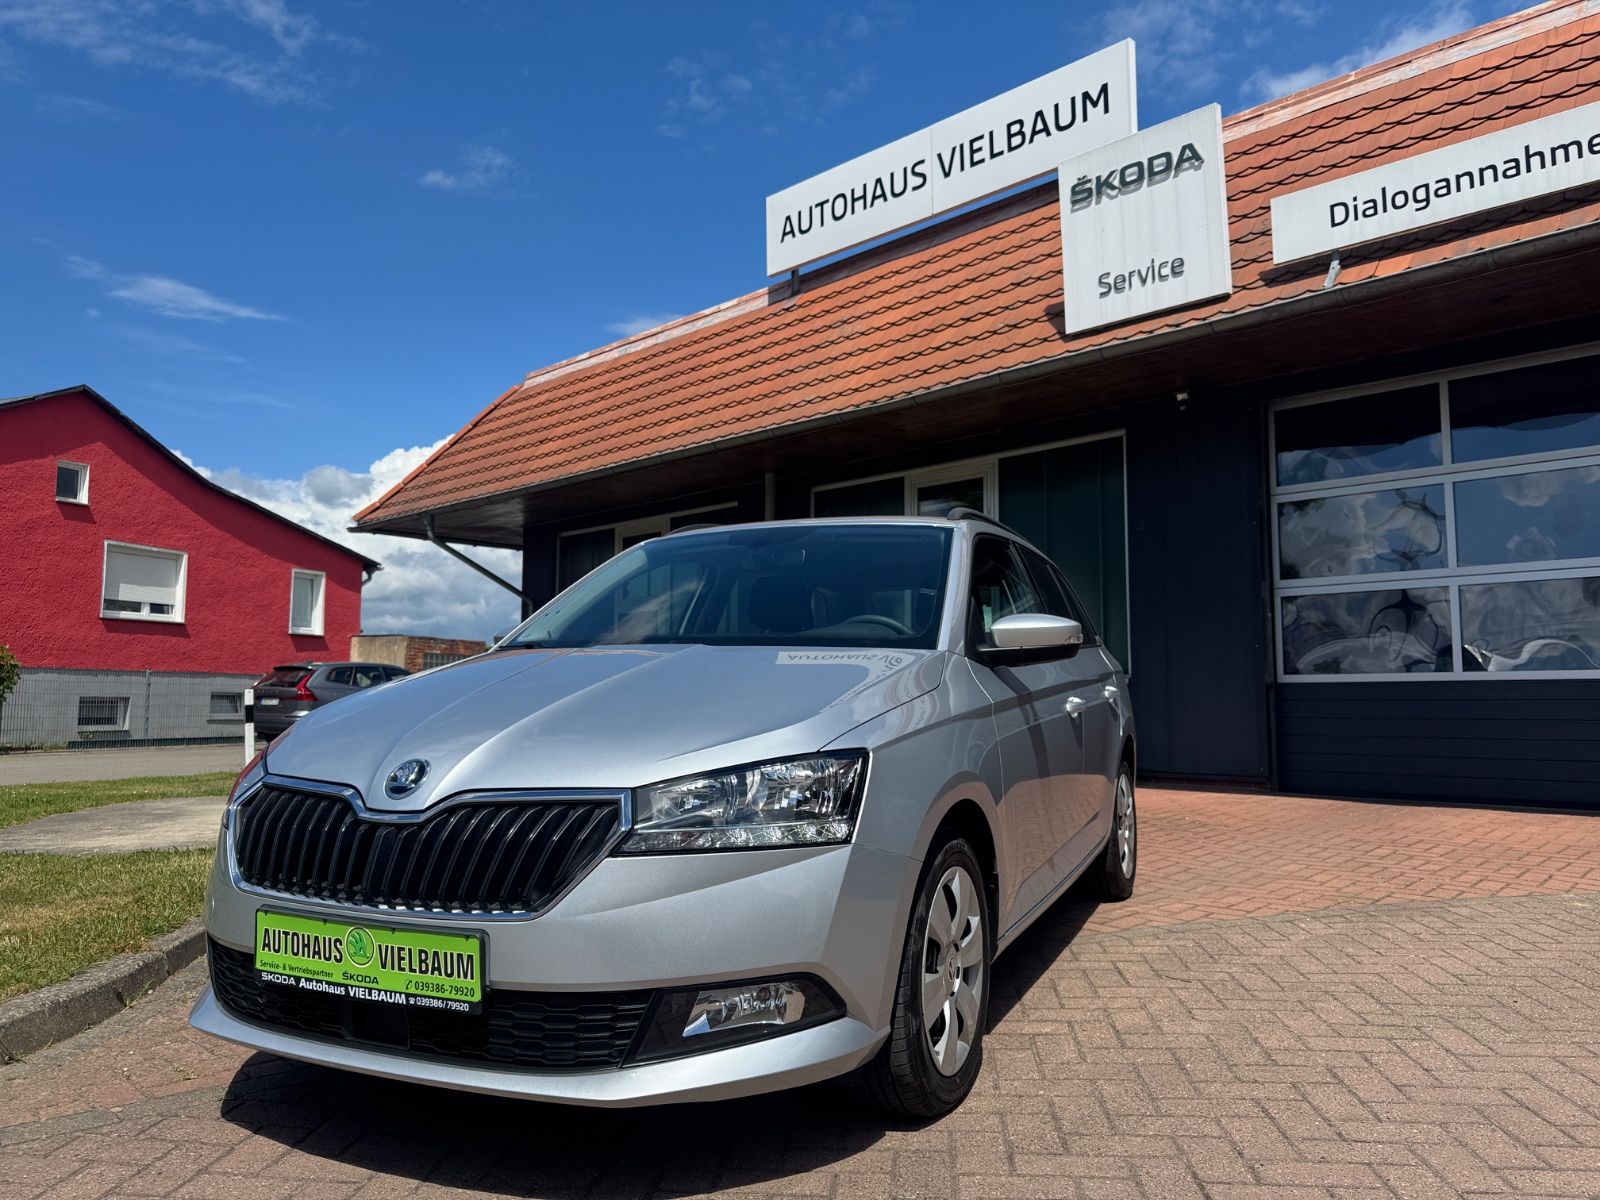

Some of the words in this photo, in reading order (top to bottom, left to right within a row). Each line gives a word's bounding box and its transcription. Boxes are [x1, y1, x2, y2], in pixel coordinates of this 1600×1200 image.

[780, 158, 928, 244] AUTOHAUS
[936, 82, 1110, 179] VIELBAUM
[1070, 142, 1205, 208] ŠKODA
[1329, 132, 1600, 228] Dialogannahme
[1098, 257, 1185, 298] Service
[262, 928, 343, 963] AUTOHAUS
[378, 944, 474, 981] VIELBAUM
[342, 971, 379, 985] ŠKODA
[299, 978, 346, 995] Autohaus
[348, 986, 406, 1005] VIELBAUM
[416, 997, 470, 1012] 039386/79920
[415, 981, 475, 998] 039386-79920
